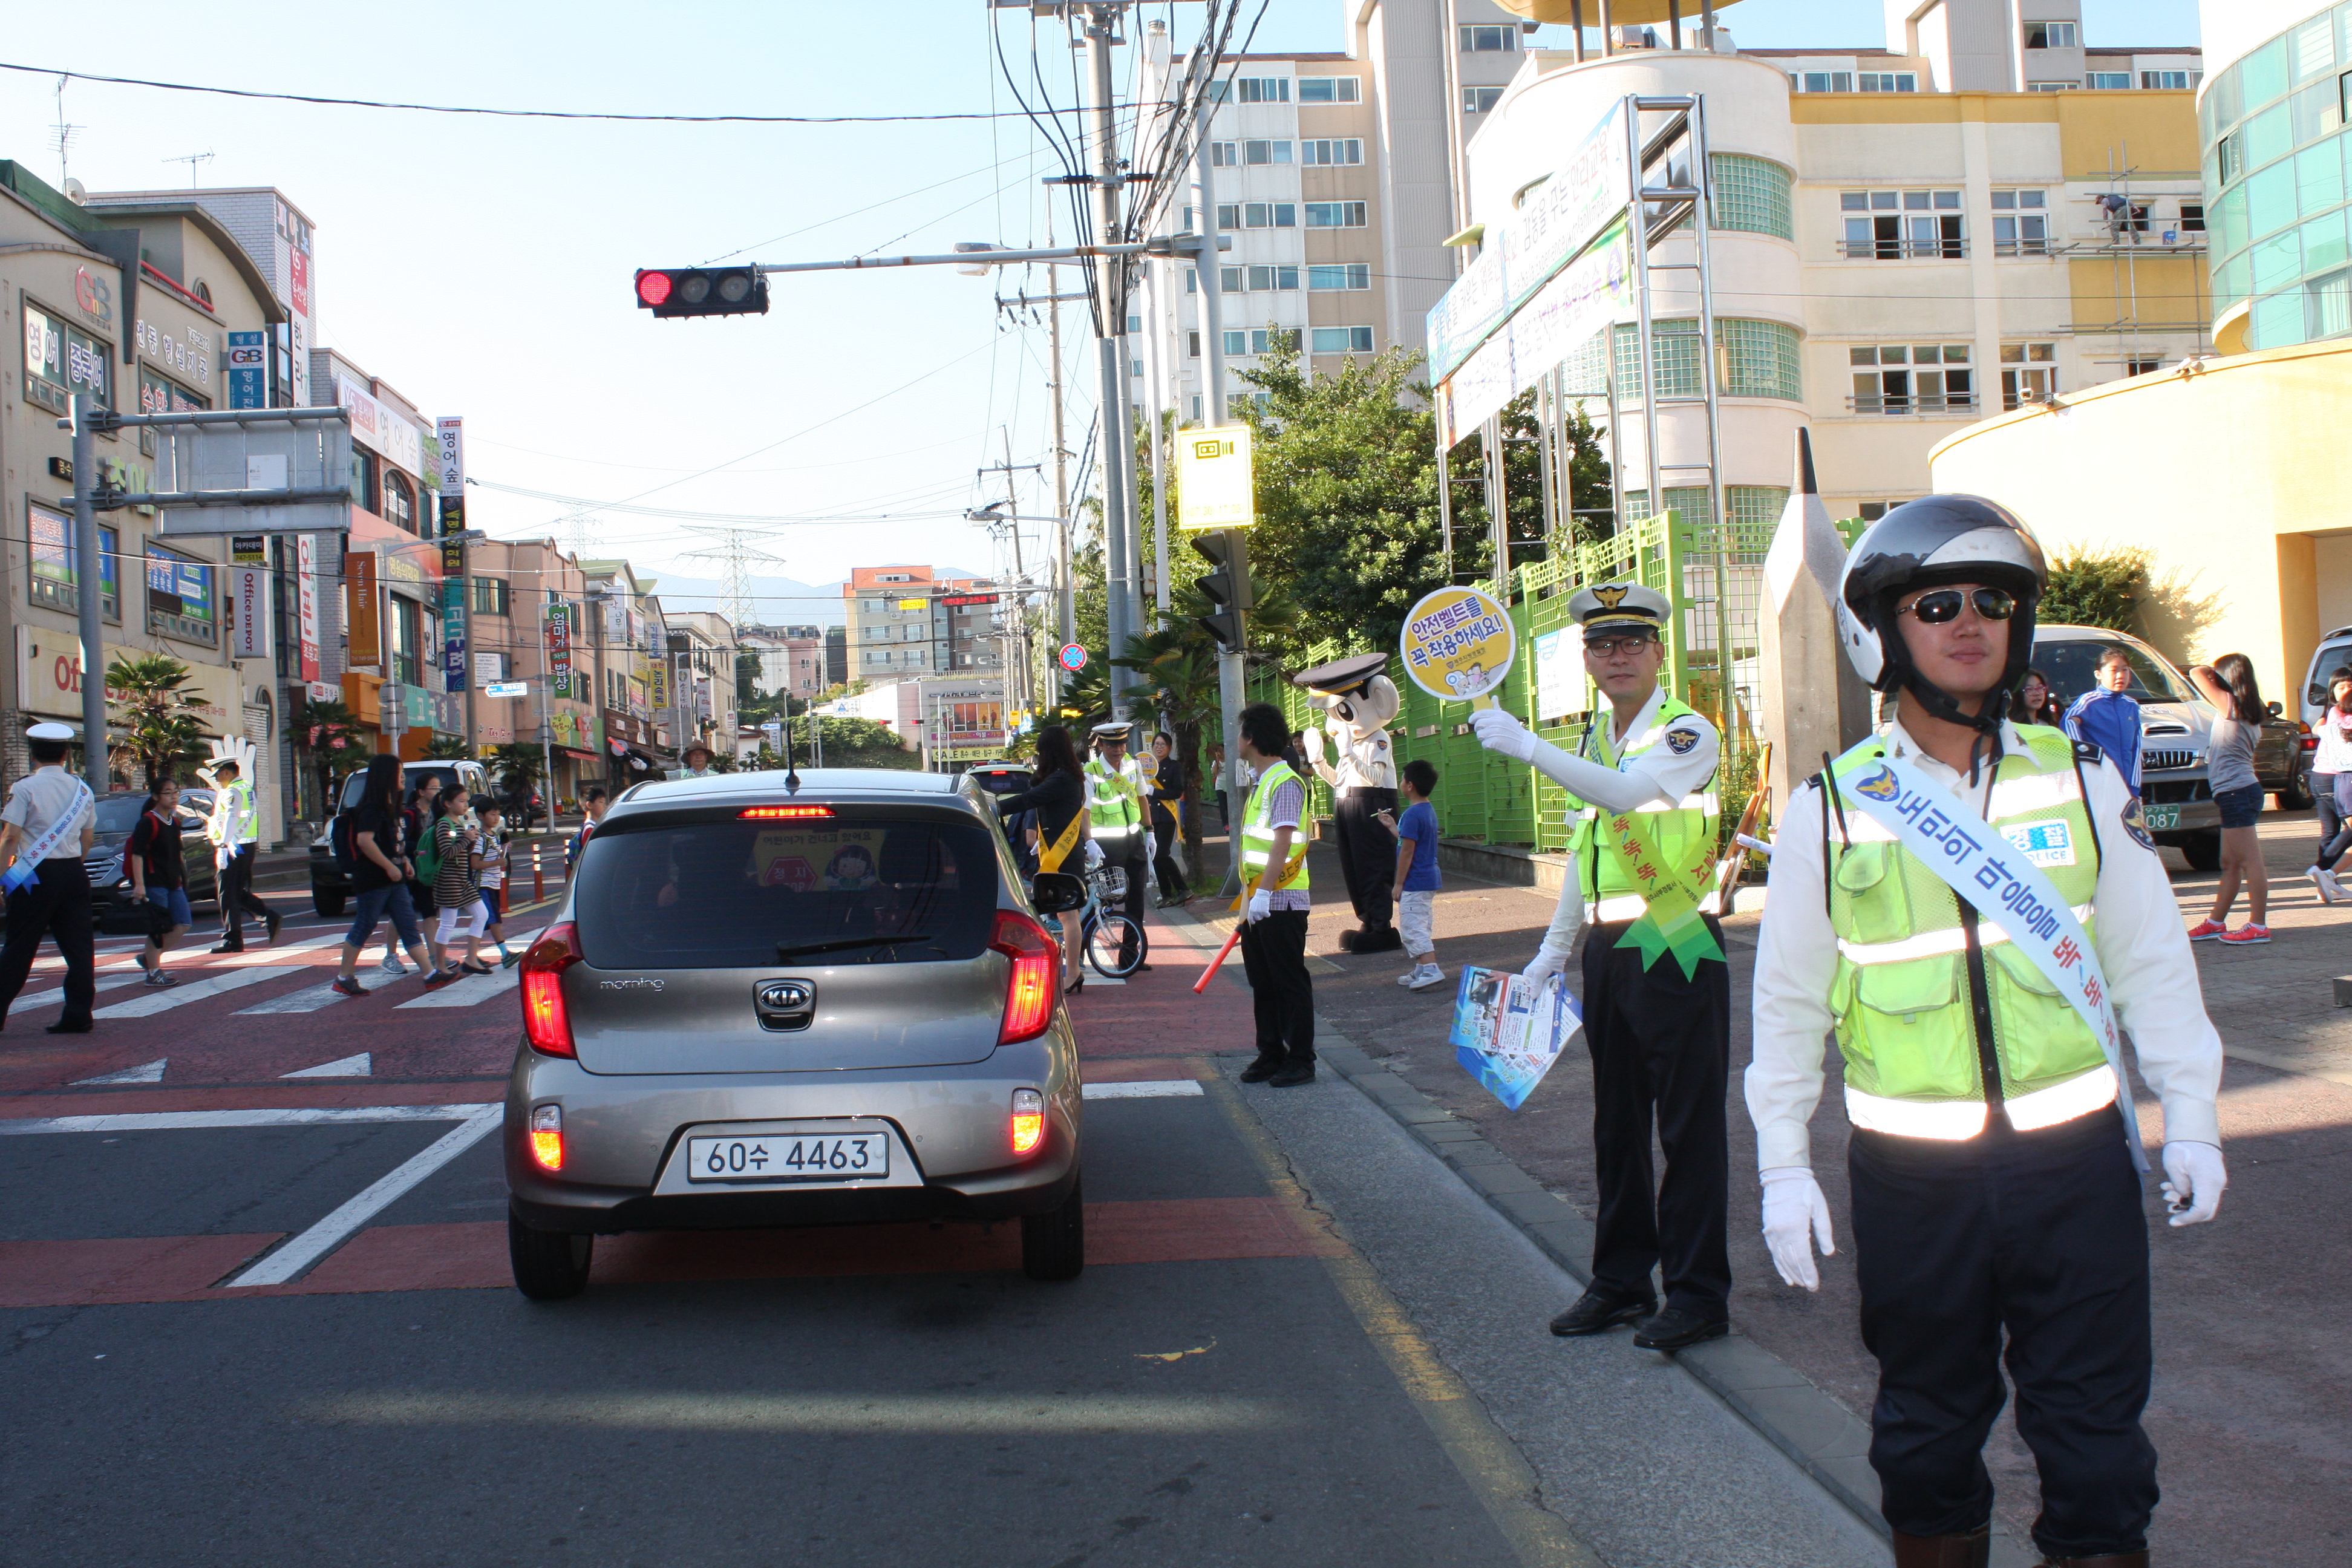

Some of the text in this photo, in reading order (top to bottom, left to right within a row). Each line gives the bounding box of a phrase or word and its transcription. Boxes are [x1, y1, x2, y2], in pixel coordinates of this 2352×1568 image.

[1522, 194, 1547, 255] 감동을
[1549, 172, 1569, 227] 주는
[70, 342, 104, 396] 중국어
[443, 431, 460, 483] 영어숲
[235, 541, 262, 549] 아카데미
[244, 573, 254, 612] Office
[553, 612, 567, 649] 엄마가
[1411, 595, 1484, 642] 안전벨트를
[1410, 647, 1430, 667] 꼭
[1427, 613, 1504, 659] 착용하세요!
[555, 663, 569, 691] 밥상
[763, 831, 872, 846] 어린이가 건너고 있어요
[1895, 788, 1983, 866] 도민의
[1973, 857, 2061, 942] 마음을
[600, 978, 664, 991] morning
[768, 990, 802, 1005] KIA
[707, 1140, 869, 1172] 60수 4463
